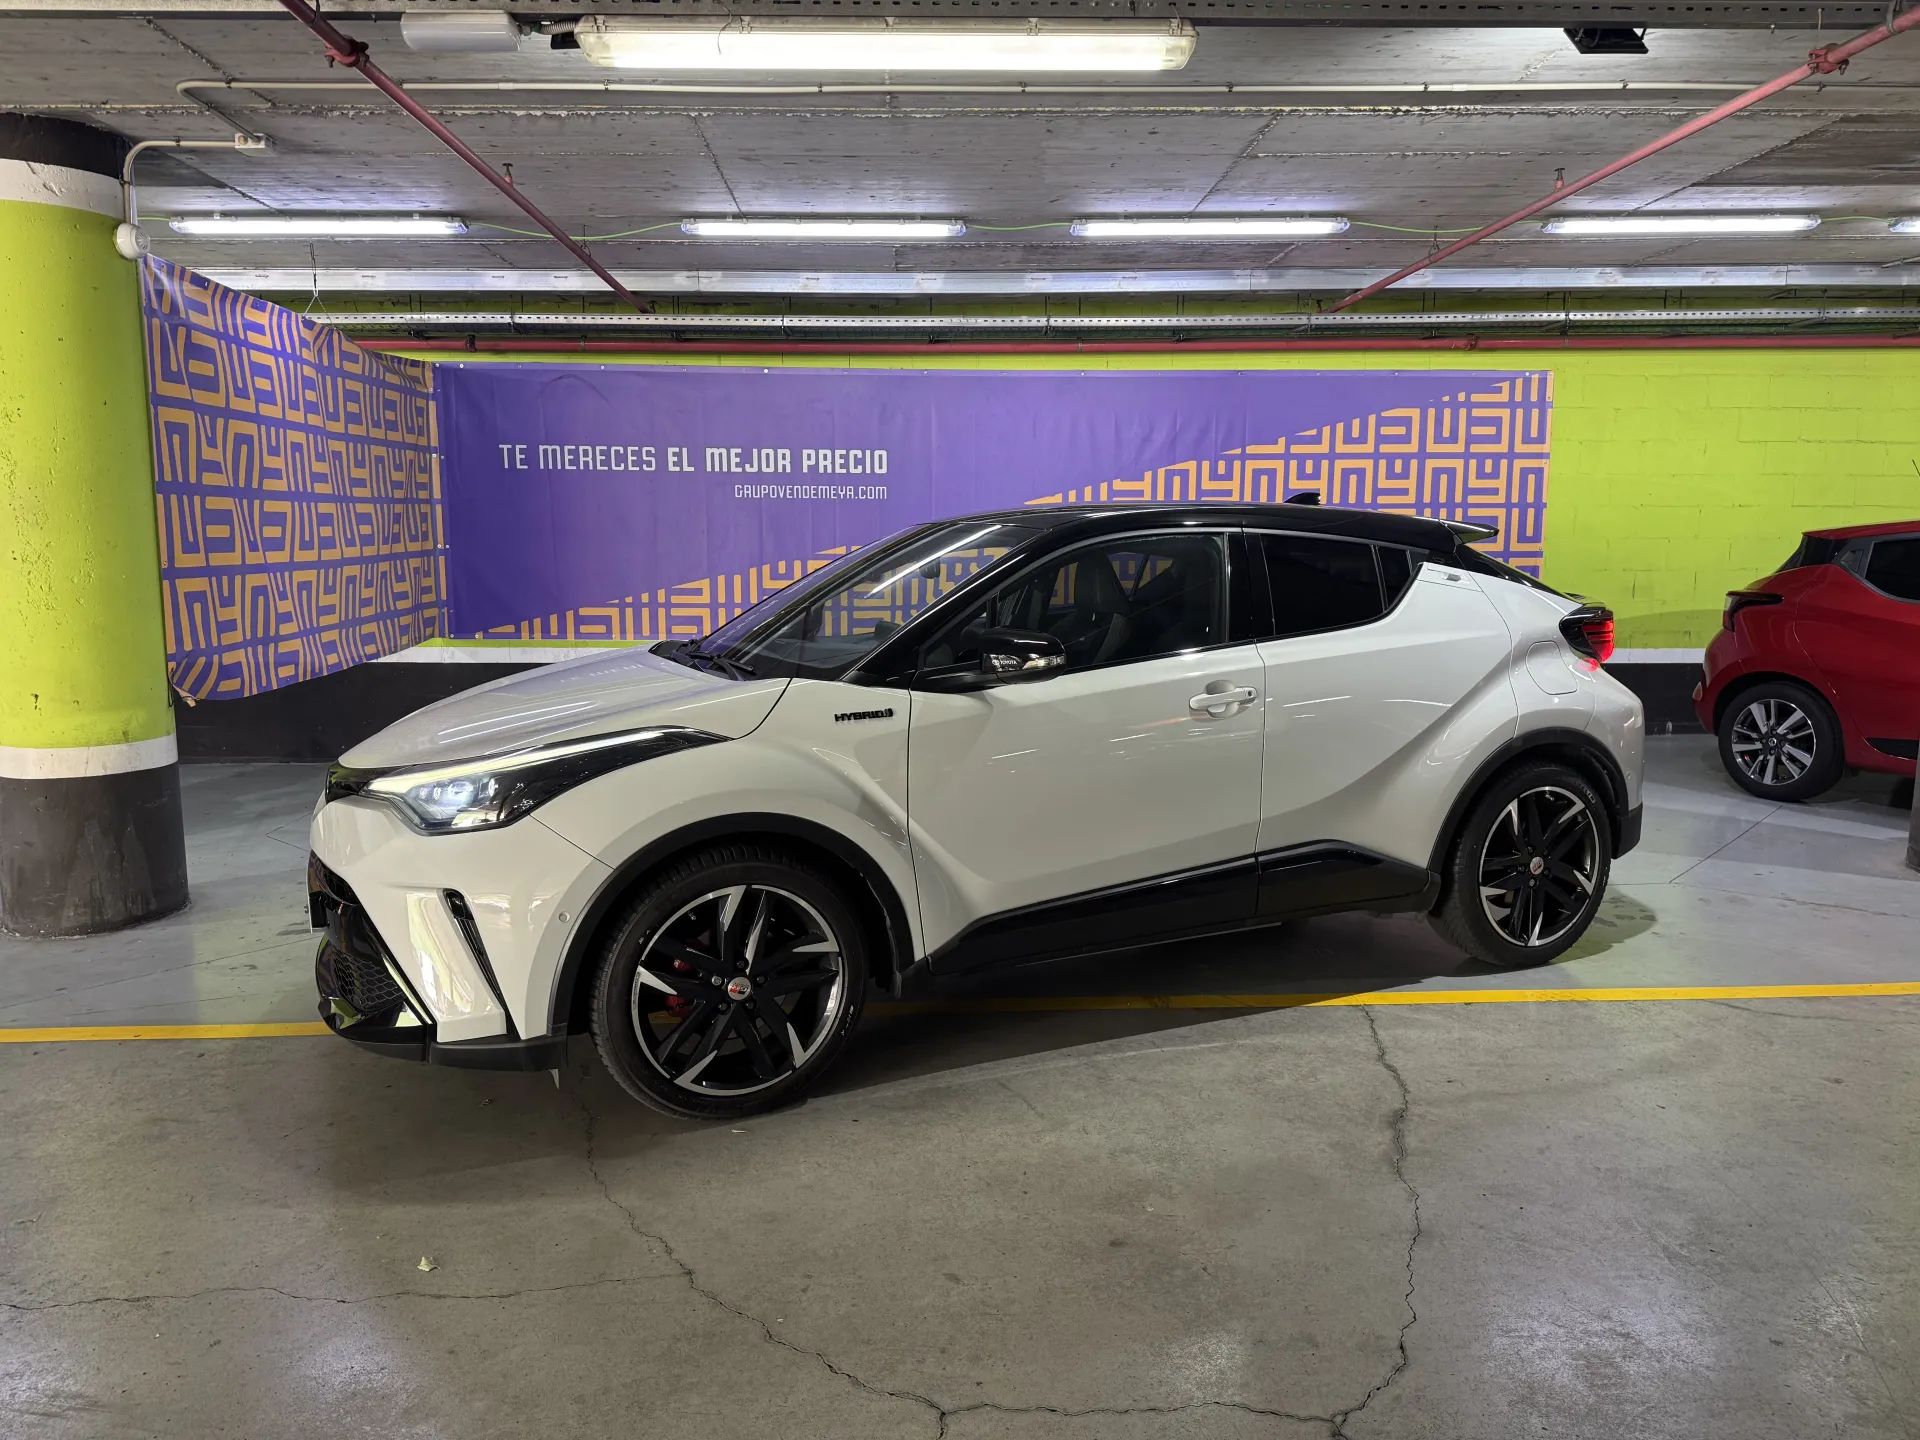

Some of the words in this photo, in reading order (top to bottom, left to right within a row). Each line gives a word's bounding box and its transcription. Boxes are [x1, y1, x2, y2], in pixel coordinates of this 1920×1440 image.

[499, 444, 529, 469] TE
[538, 444, 656, 471] MERECES
[667, 447, 695, 472] EL
[705, 447, 791, 473] MEJOR
[802, 449, 888, 474] PRECIO
[734, 484, 887, 499] GRUPOVENDEMEYA.COM
[834, 710, 884, 721] HYBRID
